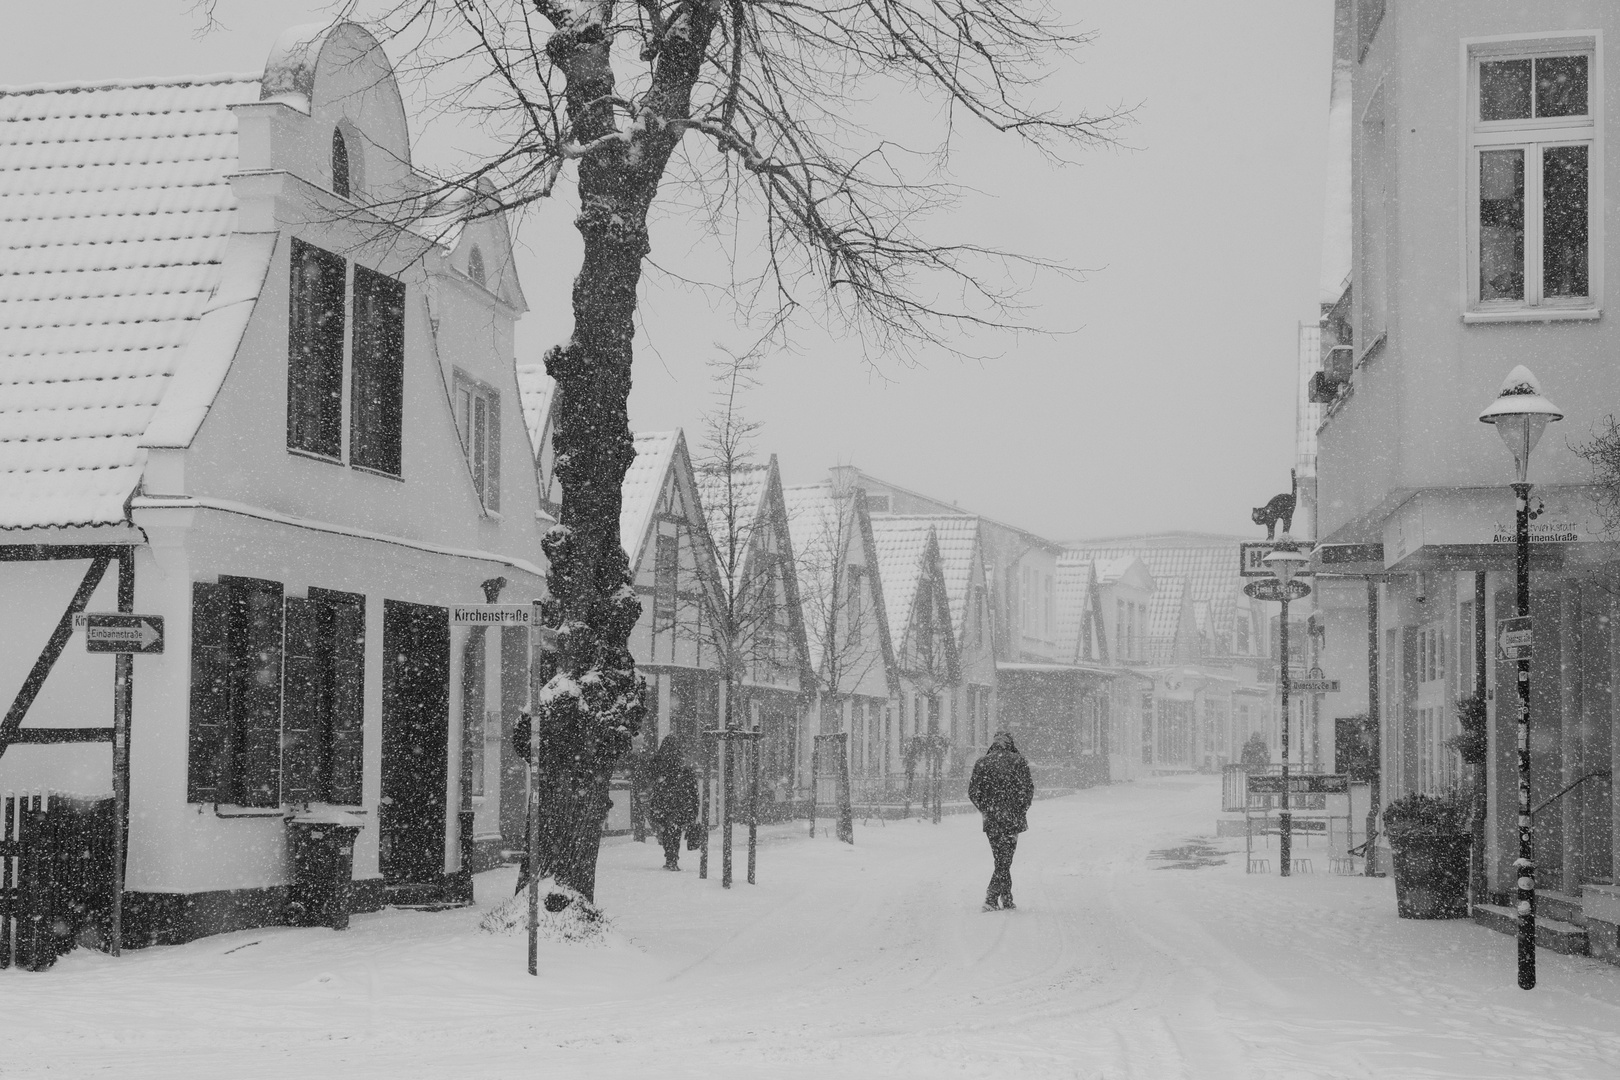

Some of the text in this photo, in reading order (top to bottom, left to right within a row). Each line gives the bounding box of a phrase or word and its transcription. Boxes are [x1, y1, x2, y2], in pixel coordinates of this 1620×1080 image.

[1493, 532, 1578, 543] Alexarinenstraße
[454, 608, 529, 622] Kirchenstraße
[91, 629, 143, 639] Einbahnstraße
